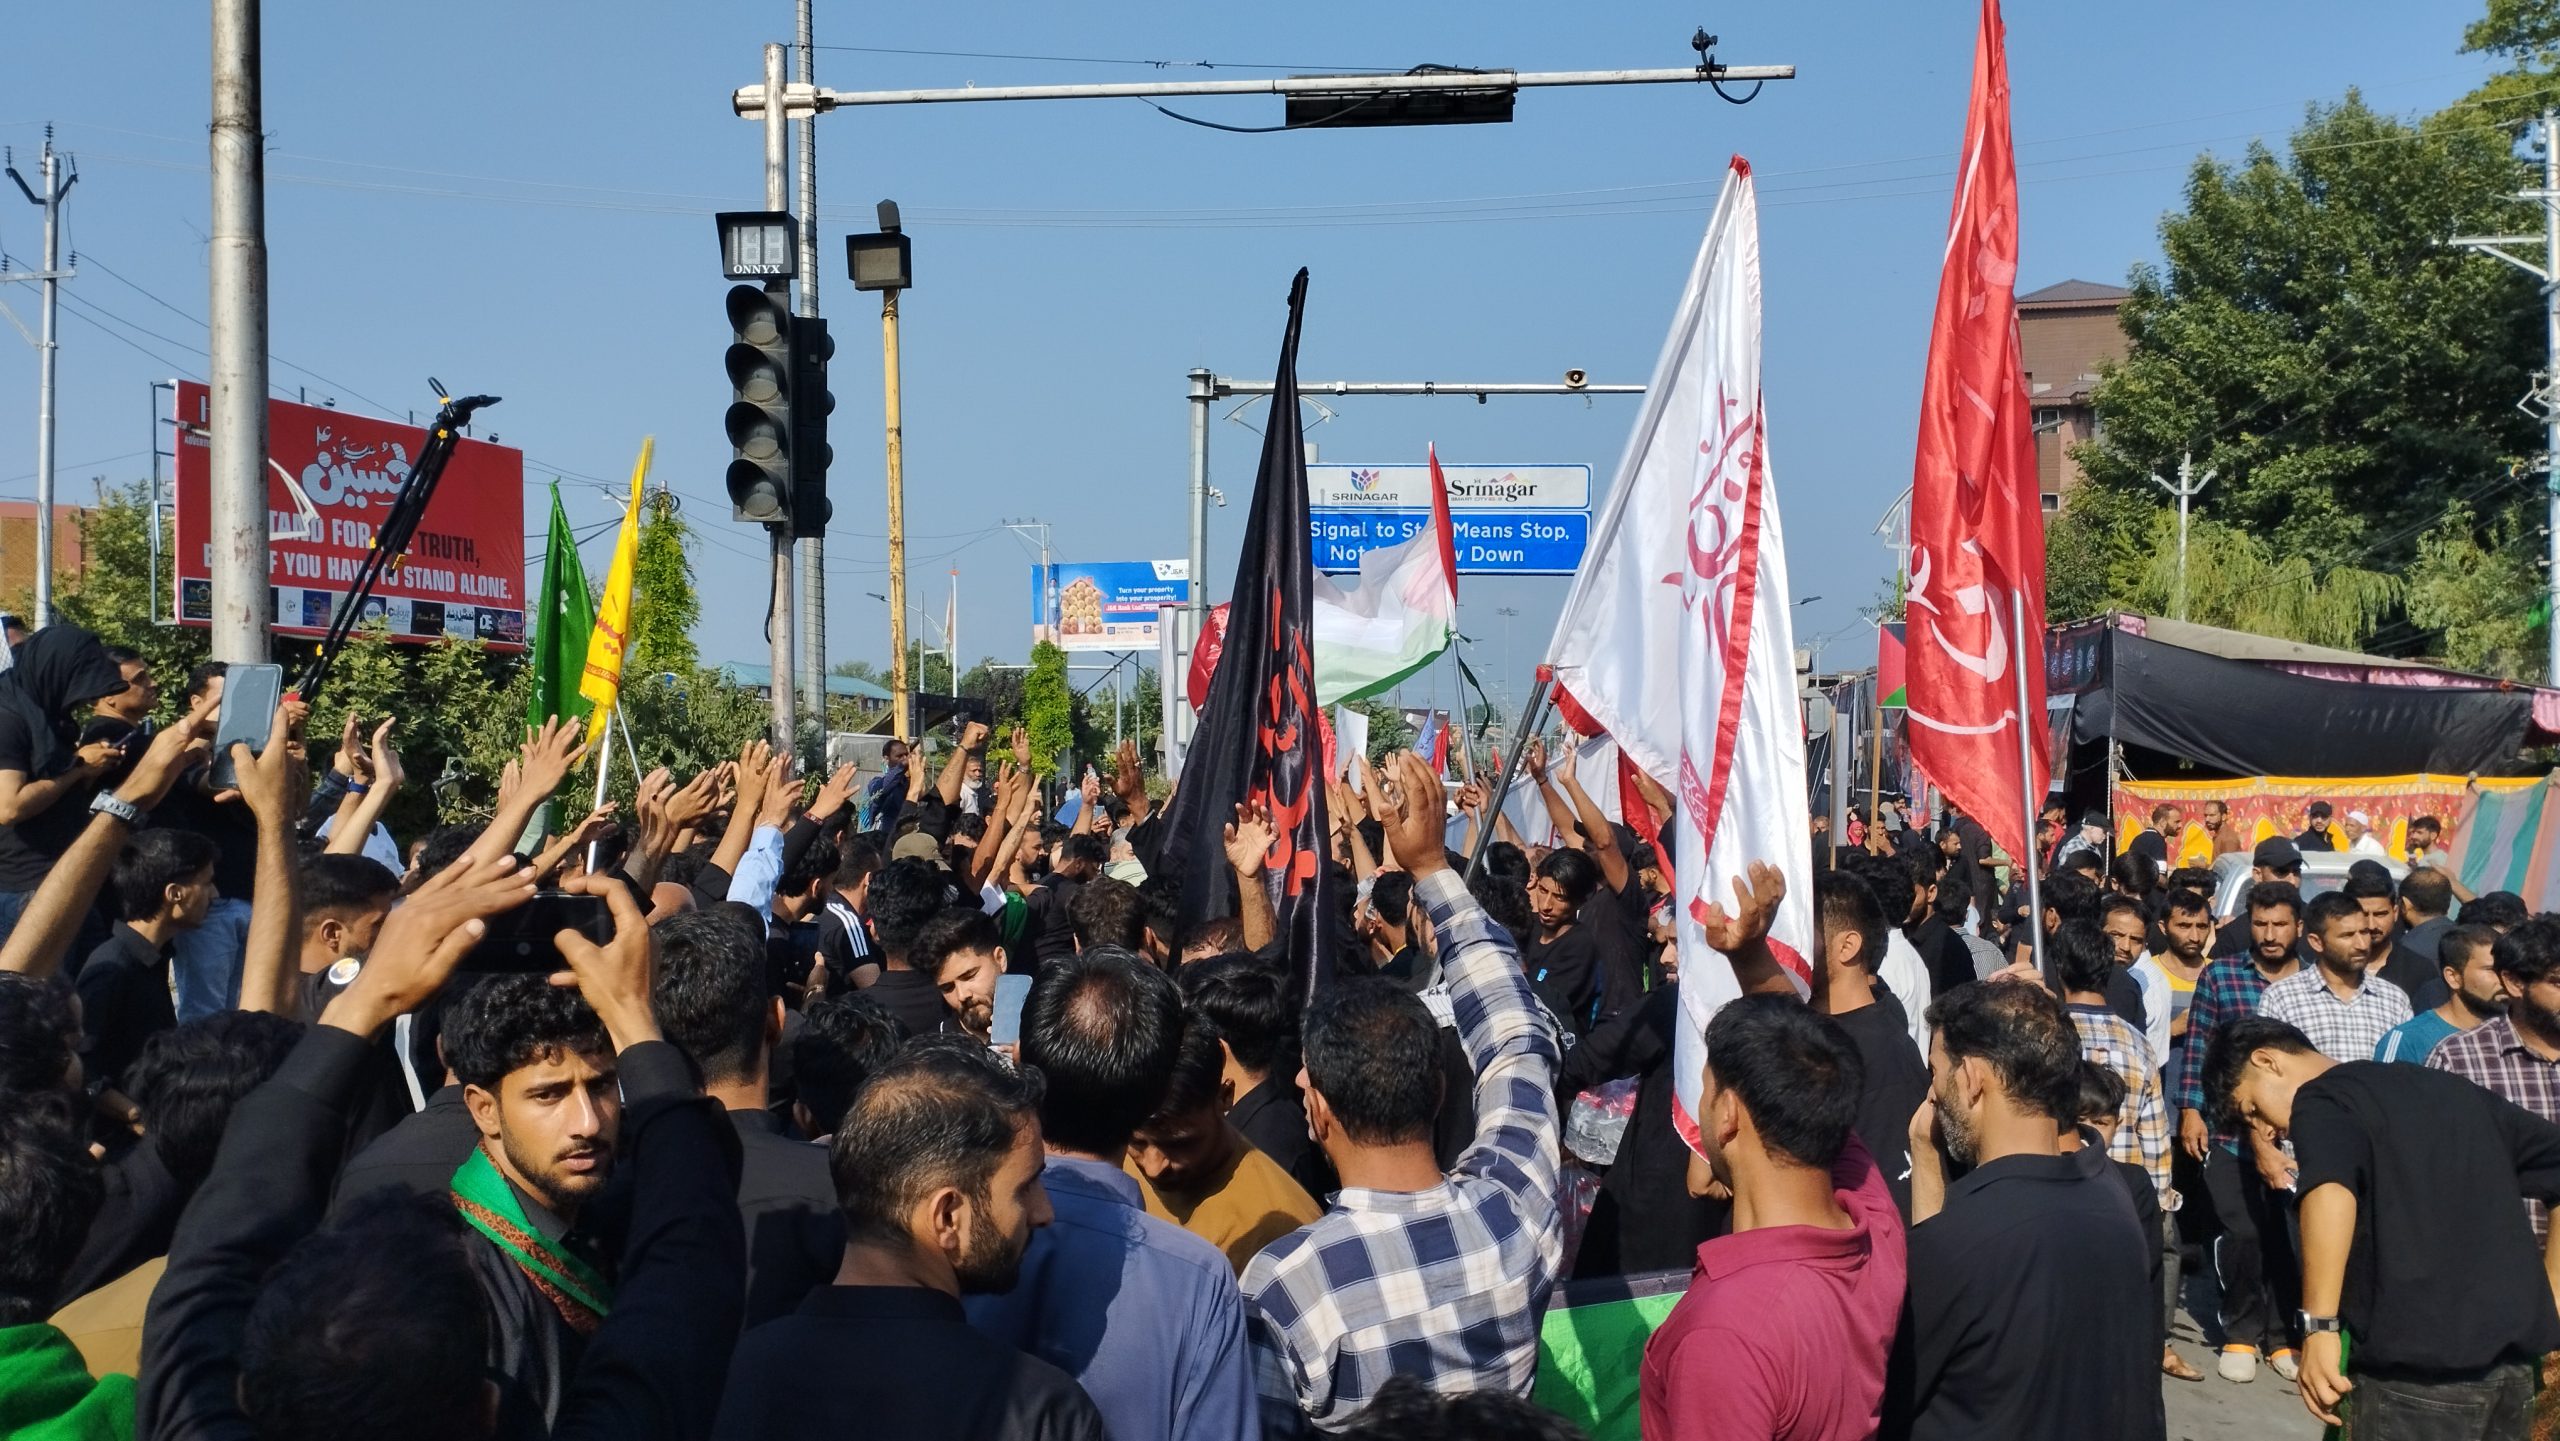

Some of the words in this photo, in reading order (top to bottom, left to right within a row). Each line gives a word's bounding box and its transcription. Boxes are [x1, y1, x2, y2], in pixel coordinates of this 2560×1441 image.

[733, 264, 781, 274] ONNYX
[1332, 493, 1399, 501] SRINAGAR
[1447, 479, 1538, 502] Srinagar
[269, 510, 325, 544] TAND
[331, 518, 372, 550] FOR
[1310, 521, 1368, 541] Signal
[1376, 522, 1396, 538] to
[1454, 522, 1513, 538] Means
[1520, 522, 1570, 542] Stop,
[417, 531, 480, 568] TRUTH,
[1471, 546, 1524, 562] Down
[283, 552, 321, 579] YOU
[403, 566, 456, 592] STAND
[460, 573, 513, 600] ALONE.
[1148, 586, 1174, 594] property
